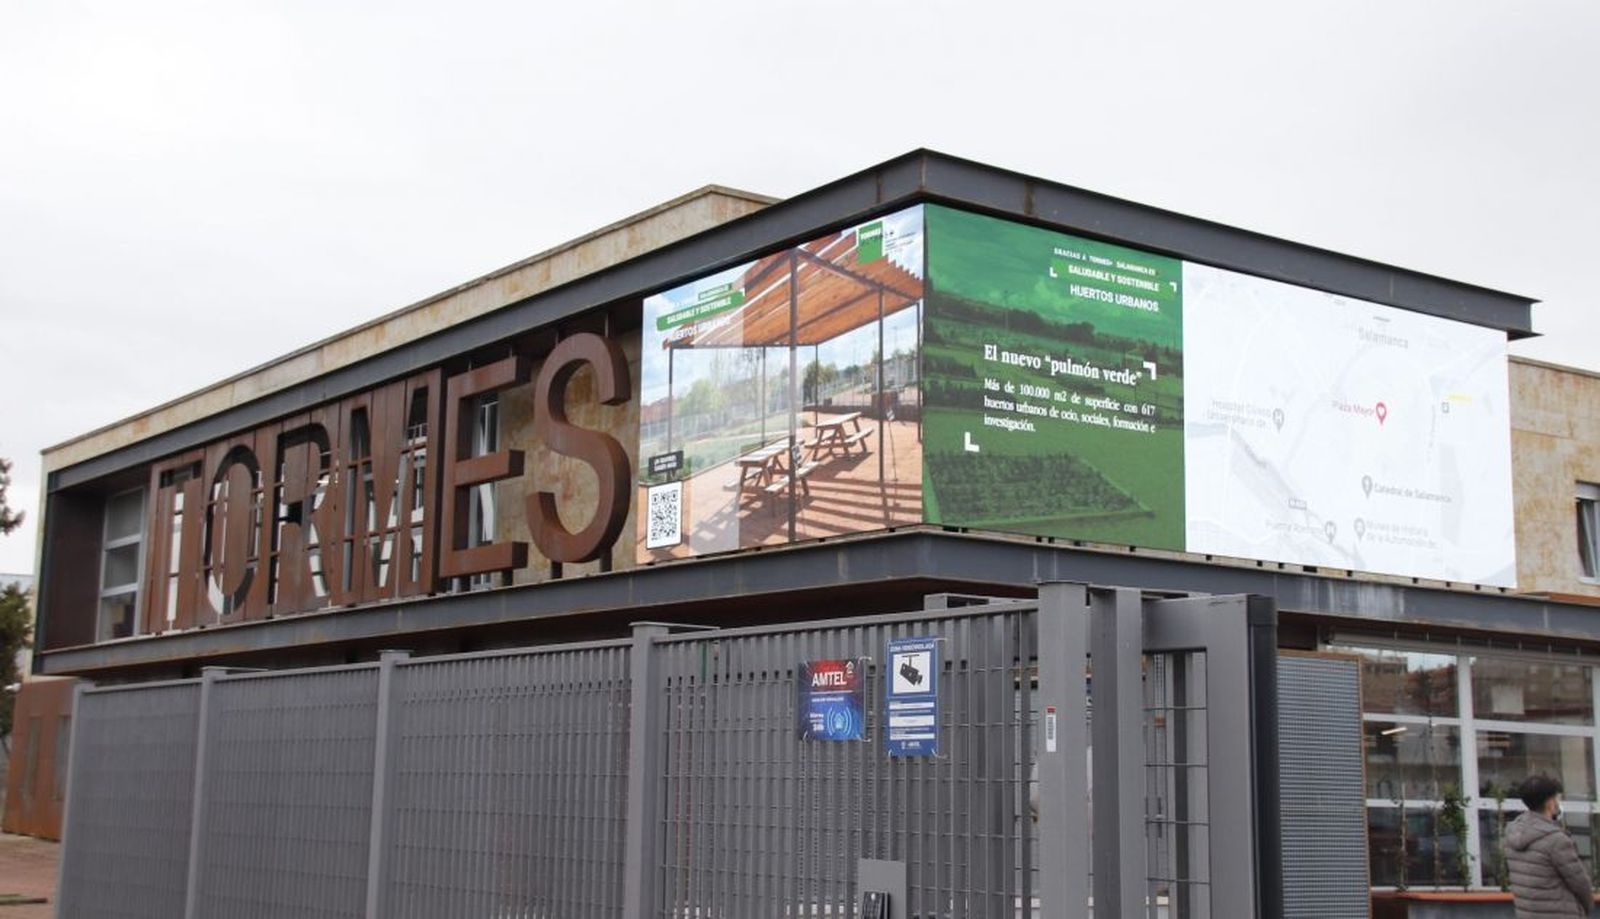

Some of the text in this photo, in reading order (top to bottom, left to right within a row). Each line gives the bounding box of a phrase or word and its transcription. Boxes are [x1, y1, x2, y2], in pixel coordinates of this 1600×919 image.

[1054, 247, 1081, 260] GRACIAS
[1068, 264, 1159, 292] SALUDABLE Y SOSTENIBLE
[1070, 283, 1159, 312] HUERTOS URBANOS
[1358, 327, 1409, 349] Salamanca
[984, 344, 998, 361] El
[1001, 352, 1042, 369] nuevo
[984, 378, 1156, 416] Más de 100.000 m2 de superficie con 617
[984, 395, 1015, 411] huertos
[1016, 401, 1047, 416] urbanos
[1049, 406, 1059, 418] de
[1061, 408, 1079, 422] ocio,
[1081, 412, 1110, 427] sociales,
[1113, 416, 1149, 432] formación
[984, 414, 1036, 432] investigación.
[148, 331, 632, 636] TORMES
[811, 671, 847, 687] AMTEL
